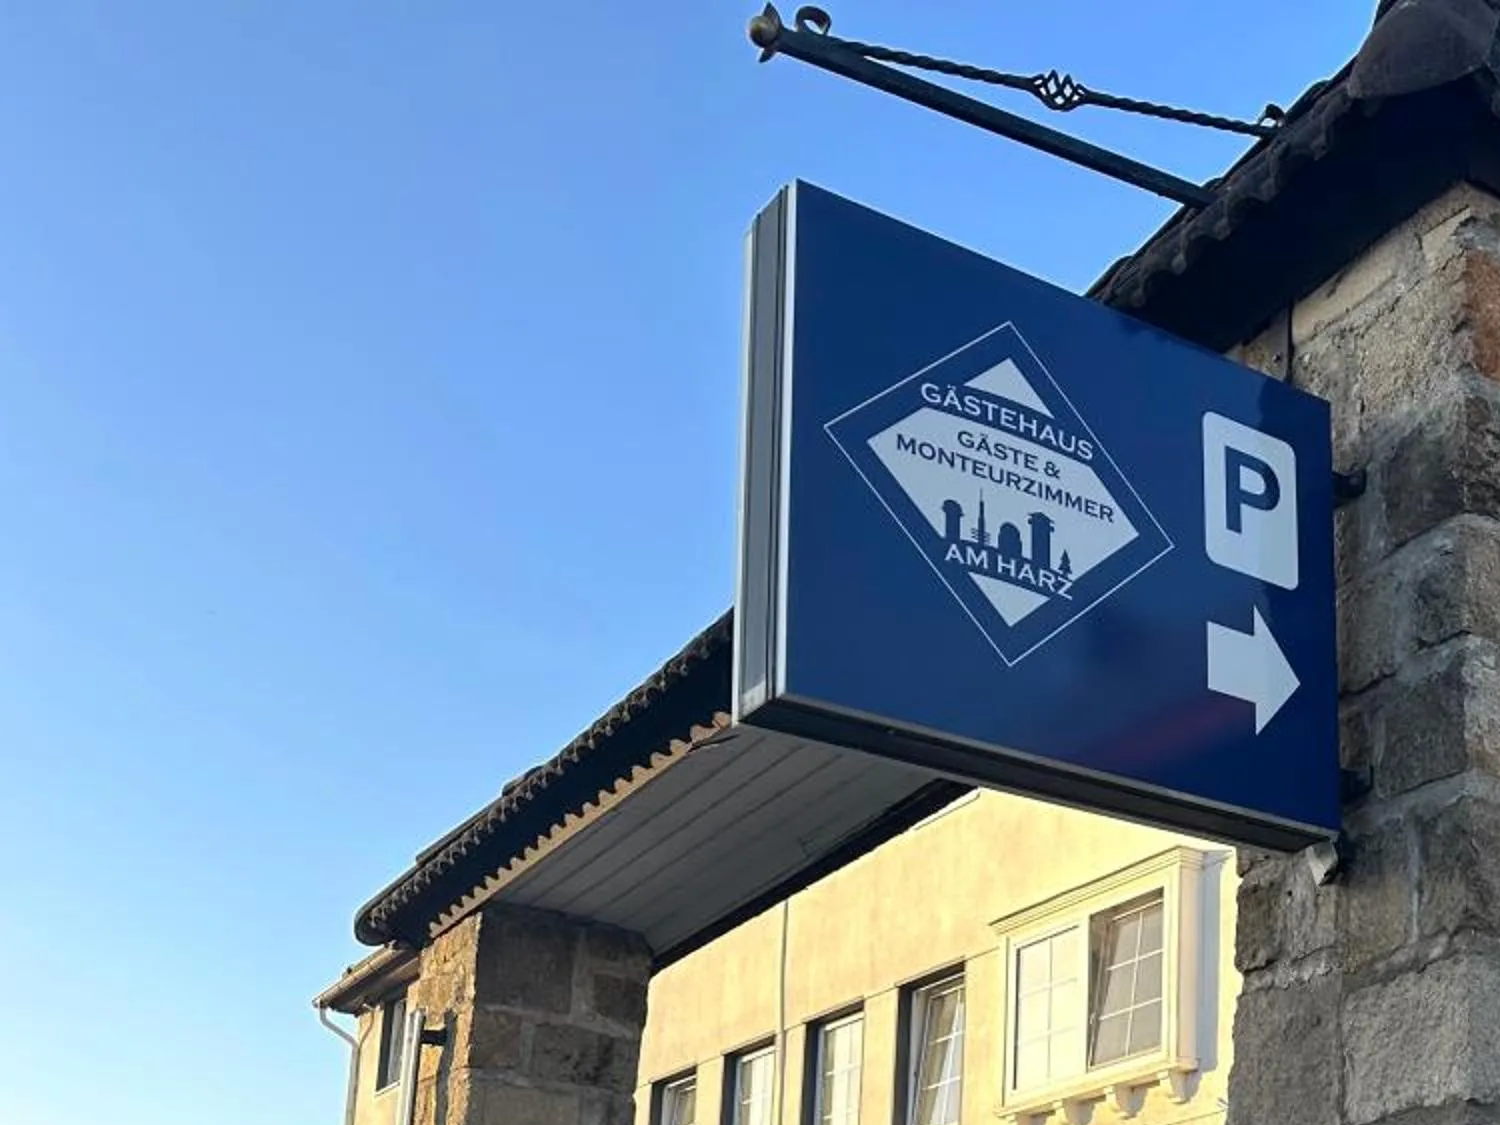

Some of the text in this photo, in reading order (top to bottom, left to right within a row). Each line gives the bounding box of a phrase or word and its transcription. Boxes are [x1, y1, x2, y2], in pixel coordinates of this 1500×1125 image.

[920, 382, 1095, 461] GÄSTEHAUS
[957, 430, 1061, 480] GÄSTE &
[896, 433, 1115, 523] MONTEURZIMMER
[1224, 445, 1281, 534] P
[944, 543, 1073, 600] AM HARZ
